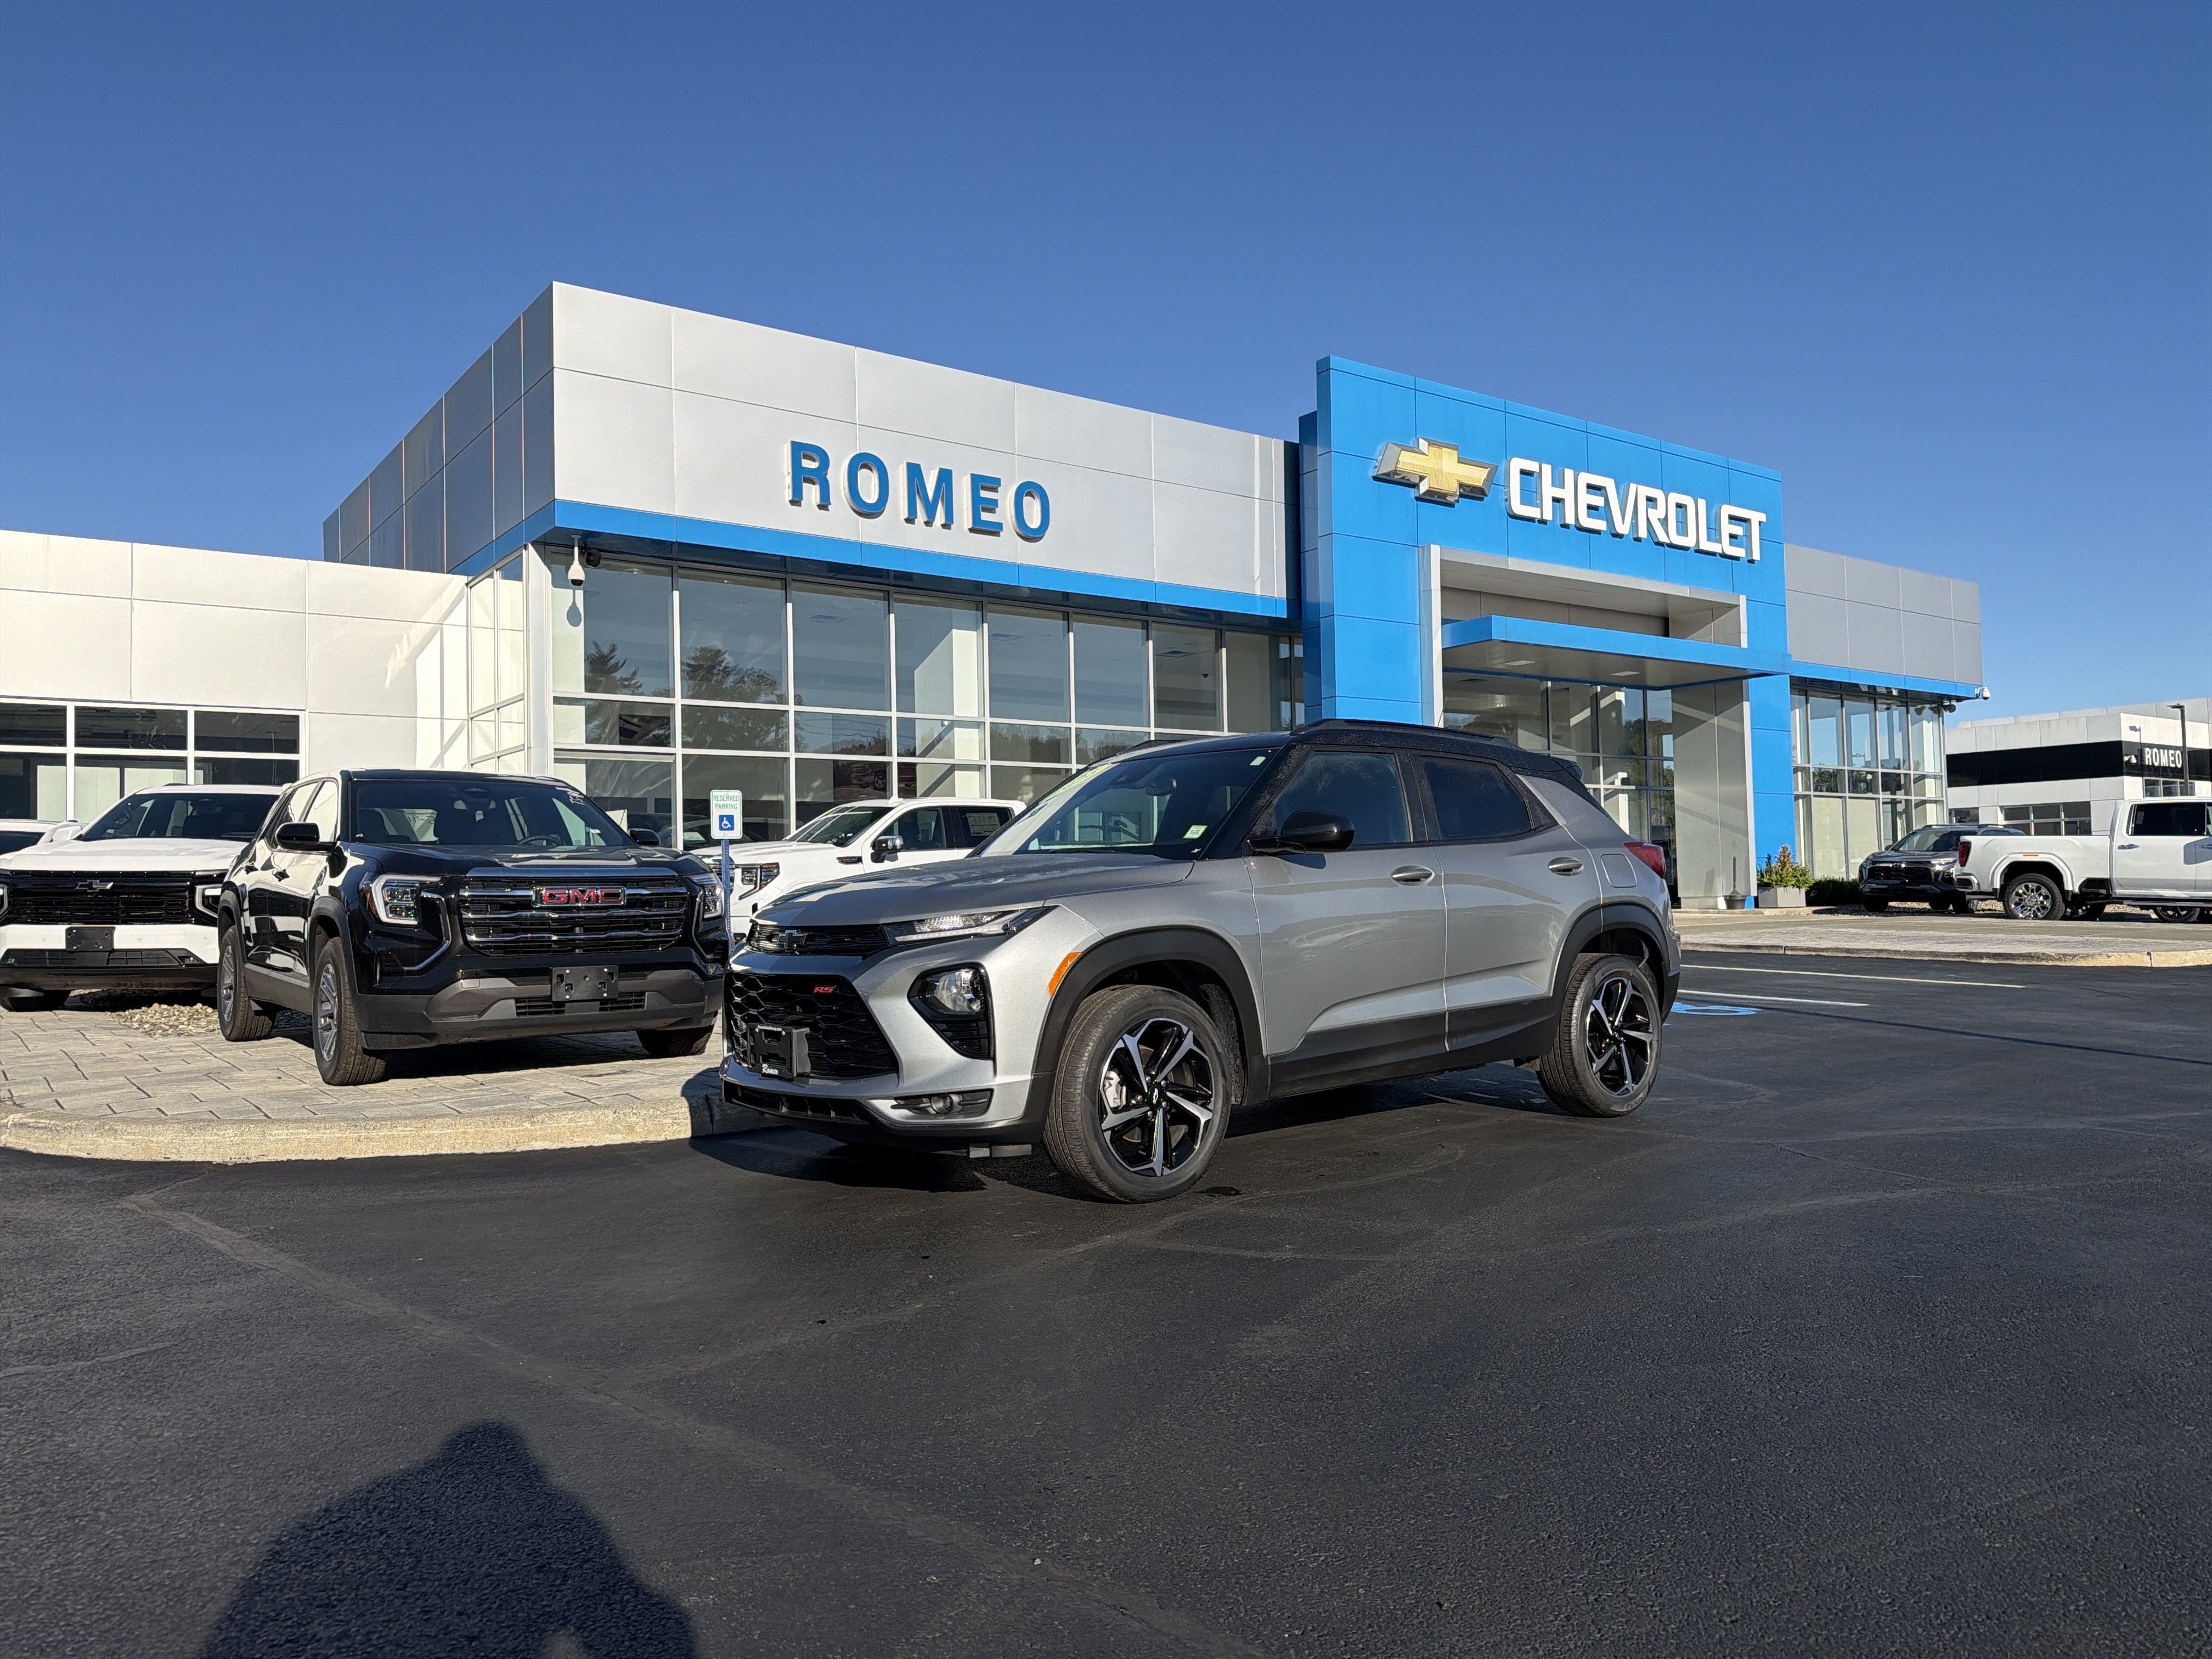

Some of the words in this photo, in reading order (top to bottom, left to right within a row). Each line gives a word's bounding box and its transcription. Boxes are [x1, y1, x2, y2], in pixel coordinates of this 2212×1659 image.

[788, 440, 1050, 541] ROMEO
[1506, 457, 1767, 561] CHEVROLET
[2145, 748, 2182, 768] ROMEO
[544, 889, 621, 904] GMC
